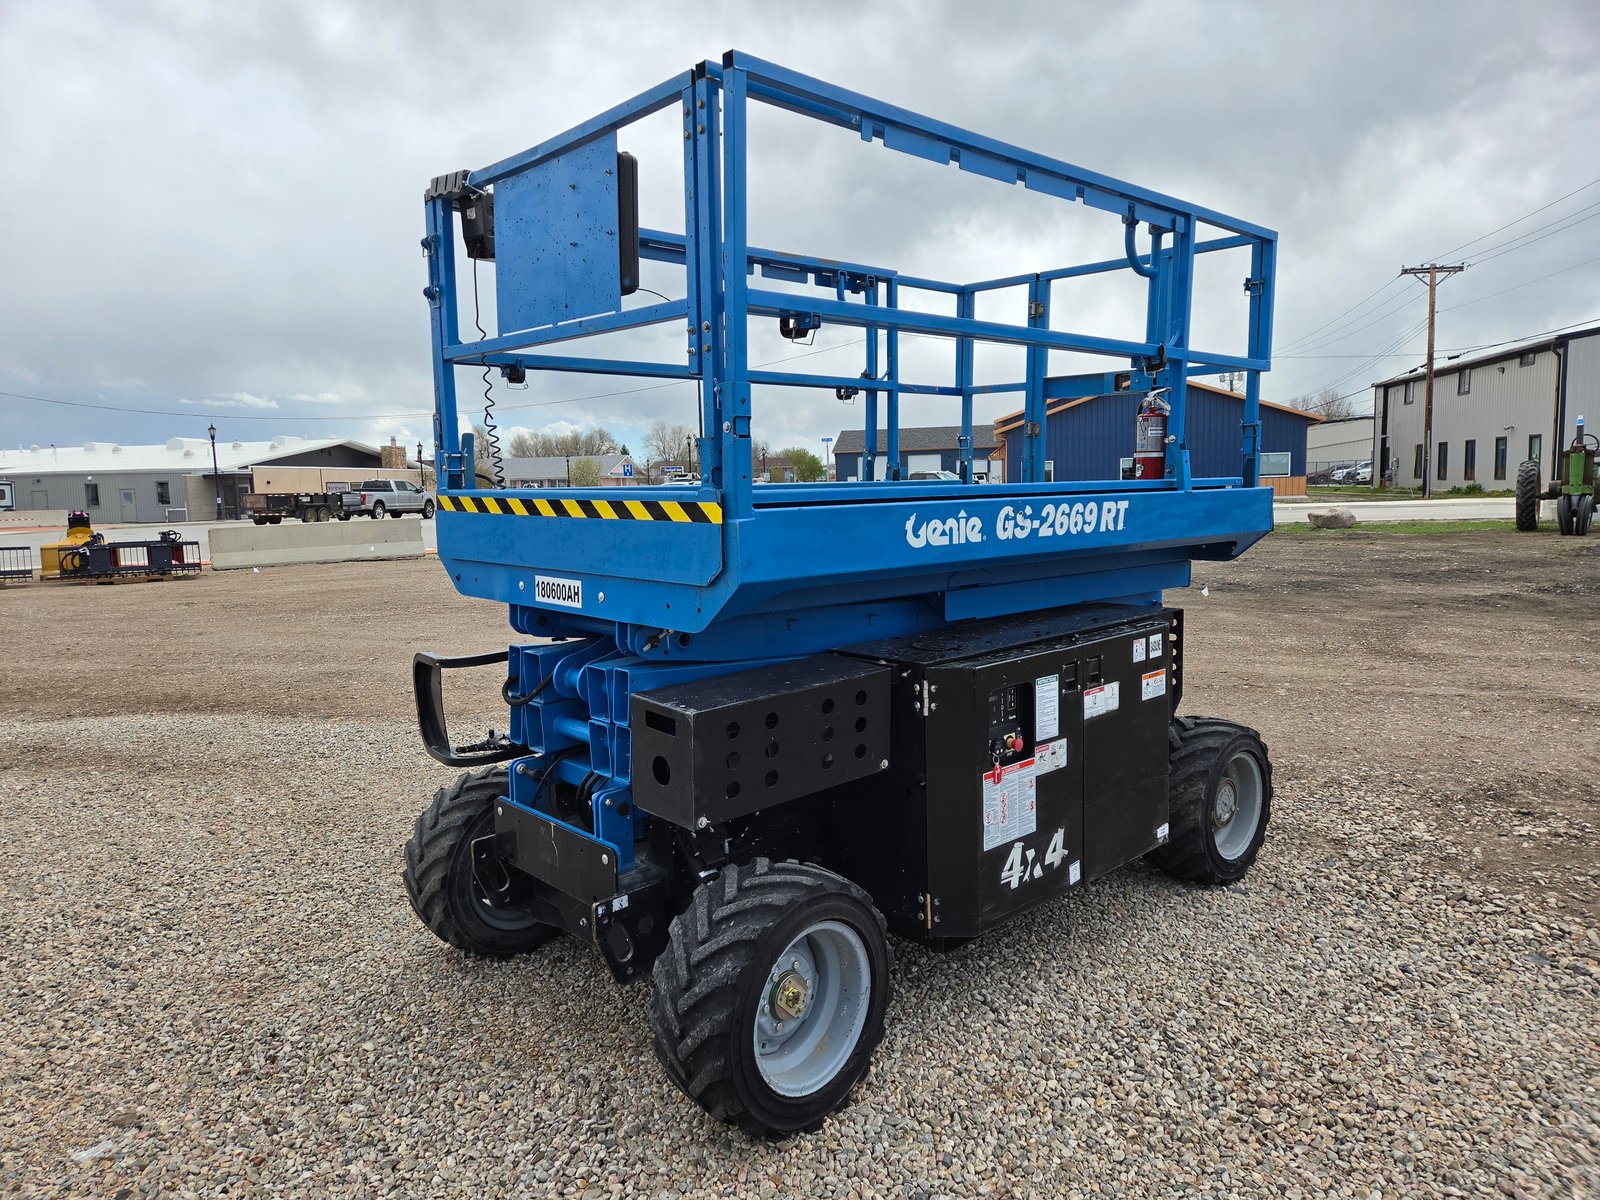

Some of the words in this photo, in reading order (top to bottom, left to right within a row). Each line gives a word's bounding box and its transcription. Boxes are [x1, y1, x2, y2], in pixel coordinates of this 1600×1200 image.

[625, 465, 631, 473] H
[996, 501, 1098, 540] GS-2669
[1100, 501, 1129, 532] RT
[536, 580, 580, 603] 180600AH
